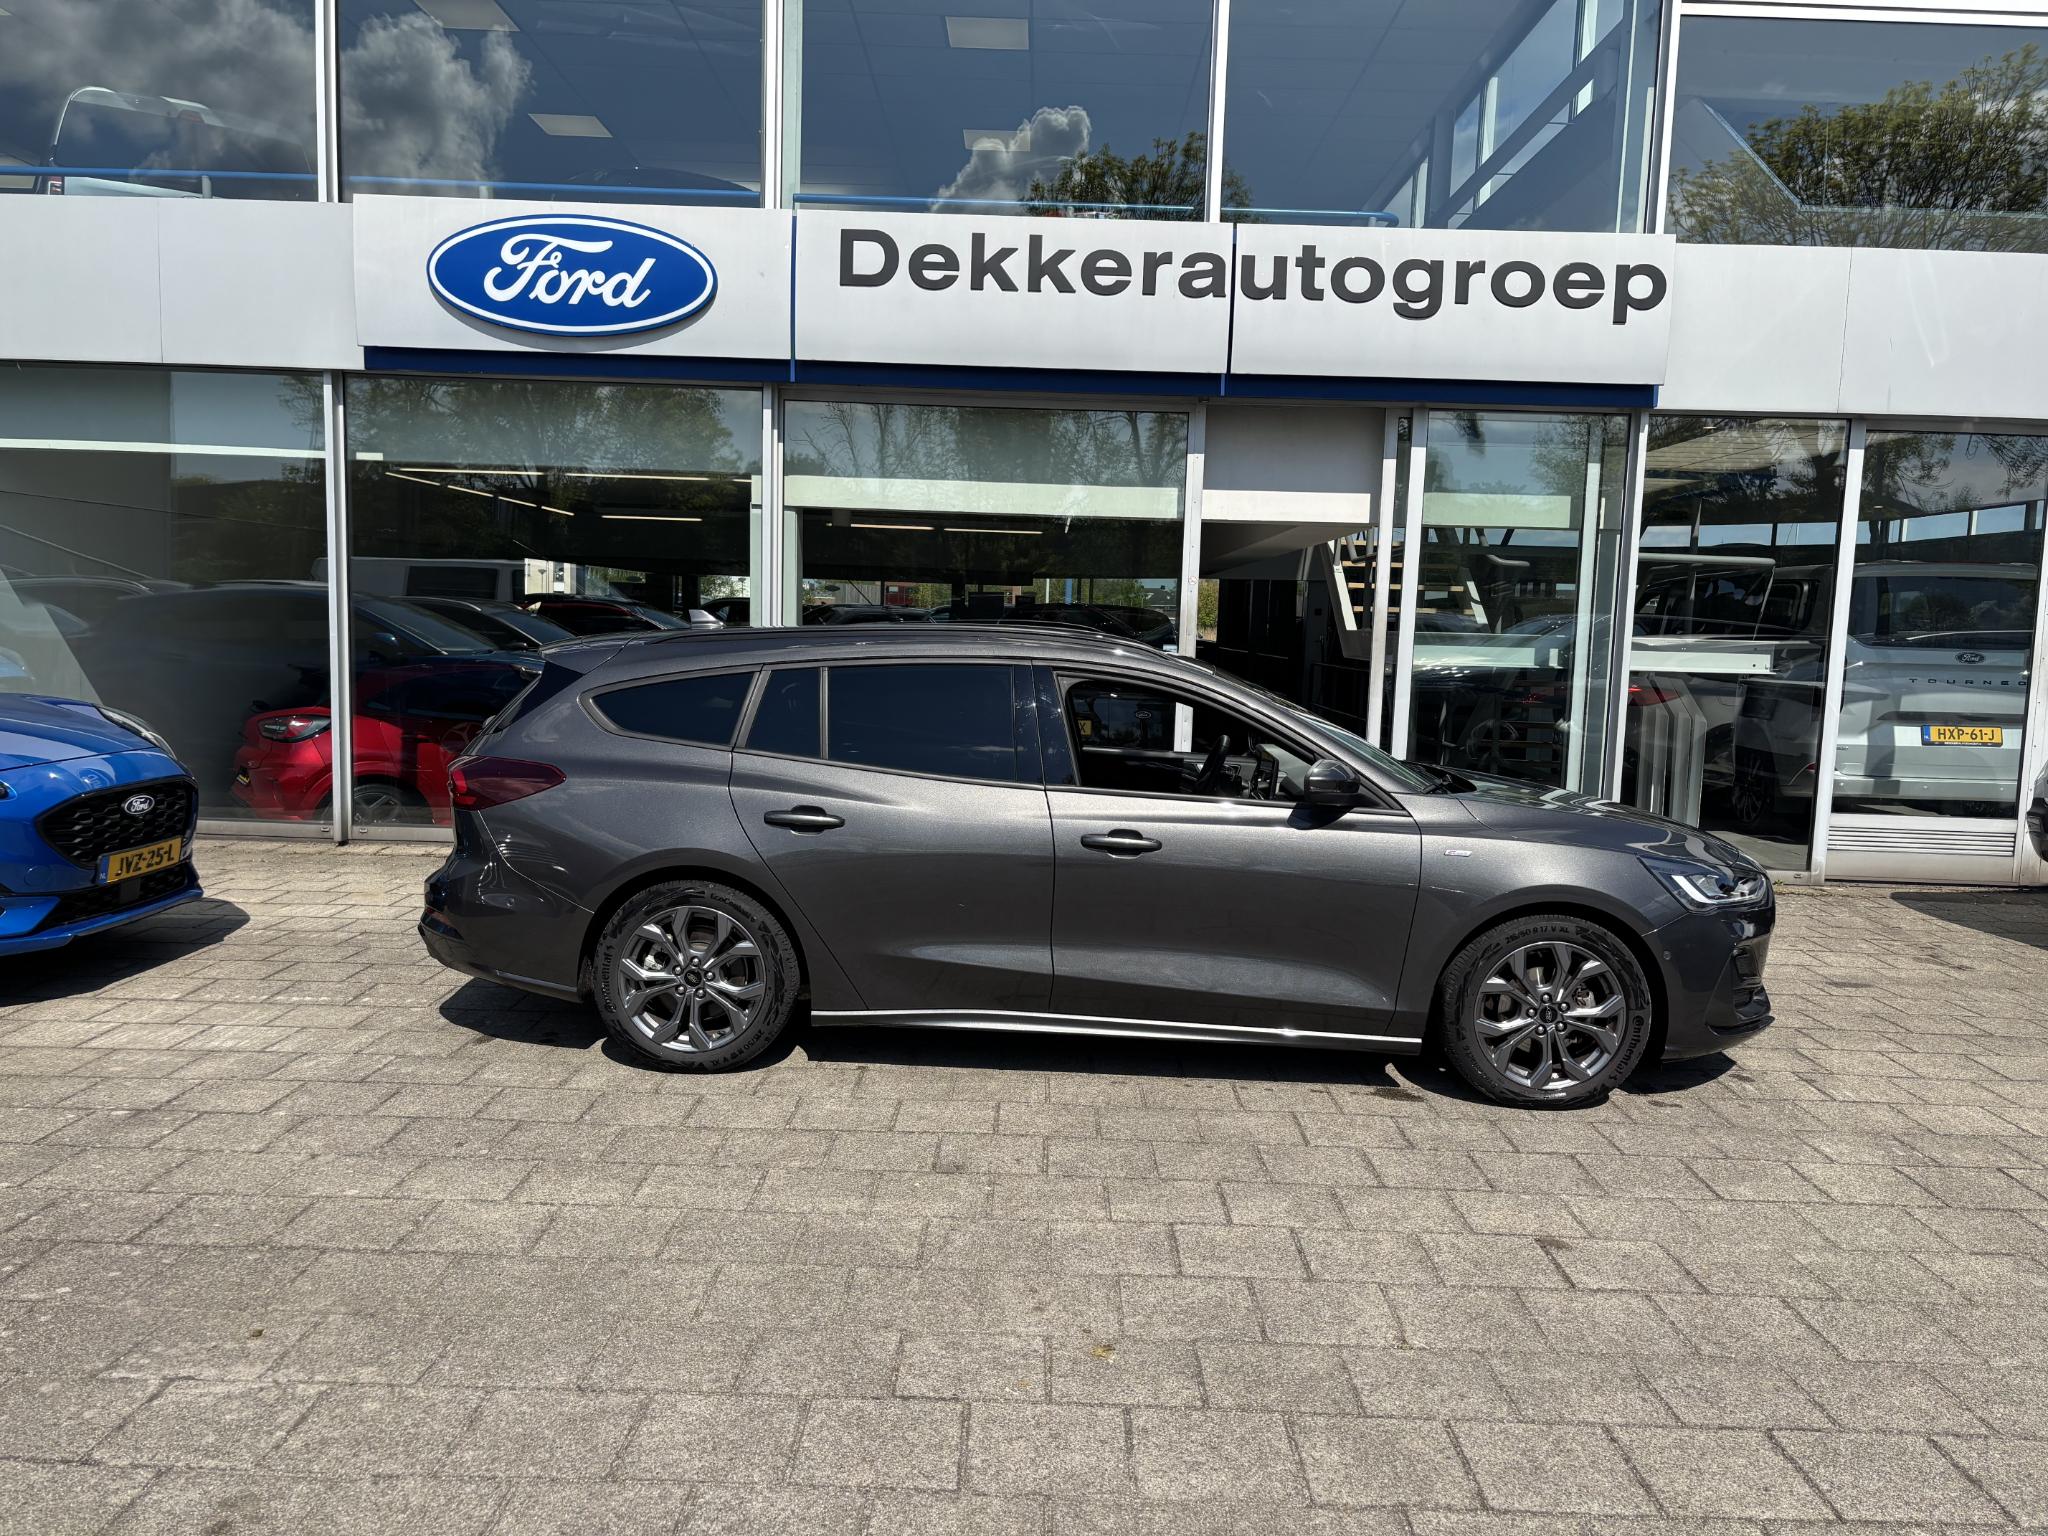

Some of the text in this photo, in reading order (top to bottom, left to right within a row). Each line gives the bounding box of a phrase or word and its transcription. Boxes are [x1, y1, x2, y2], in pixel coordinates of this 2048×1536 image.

[484, 233, 656, 308] Ford
[838, 228, 1668, 326] Dekkerautogroep
[1909, 678, 2028, 687] TOURNEO
[1937, 728, 1996, 742] HXP-61-J
[114, 843, 175, 877] JVZ-25-L
